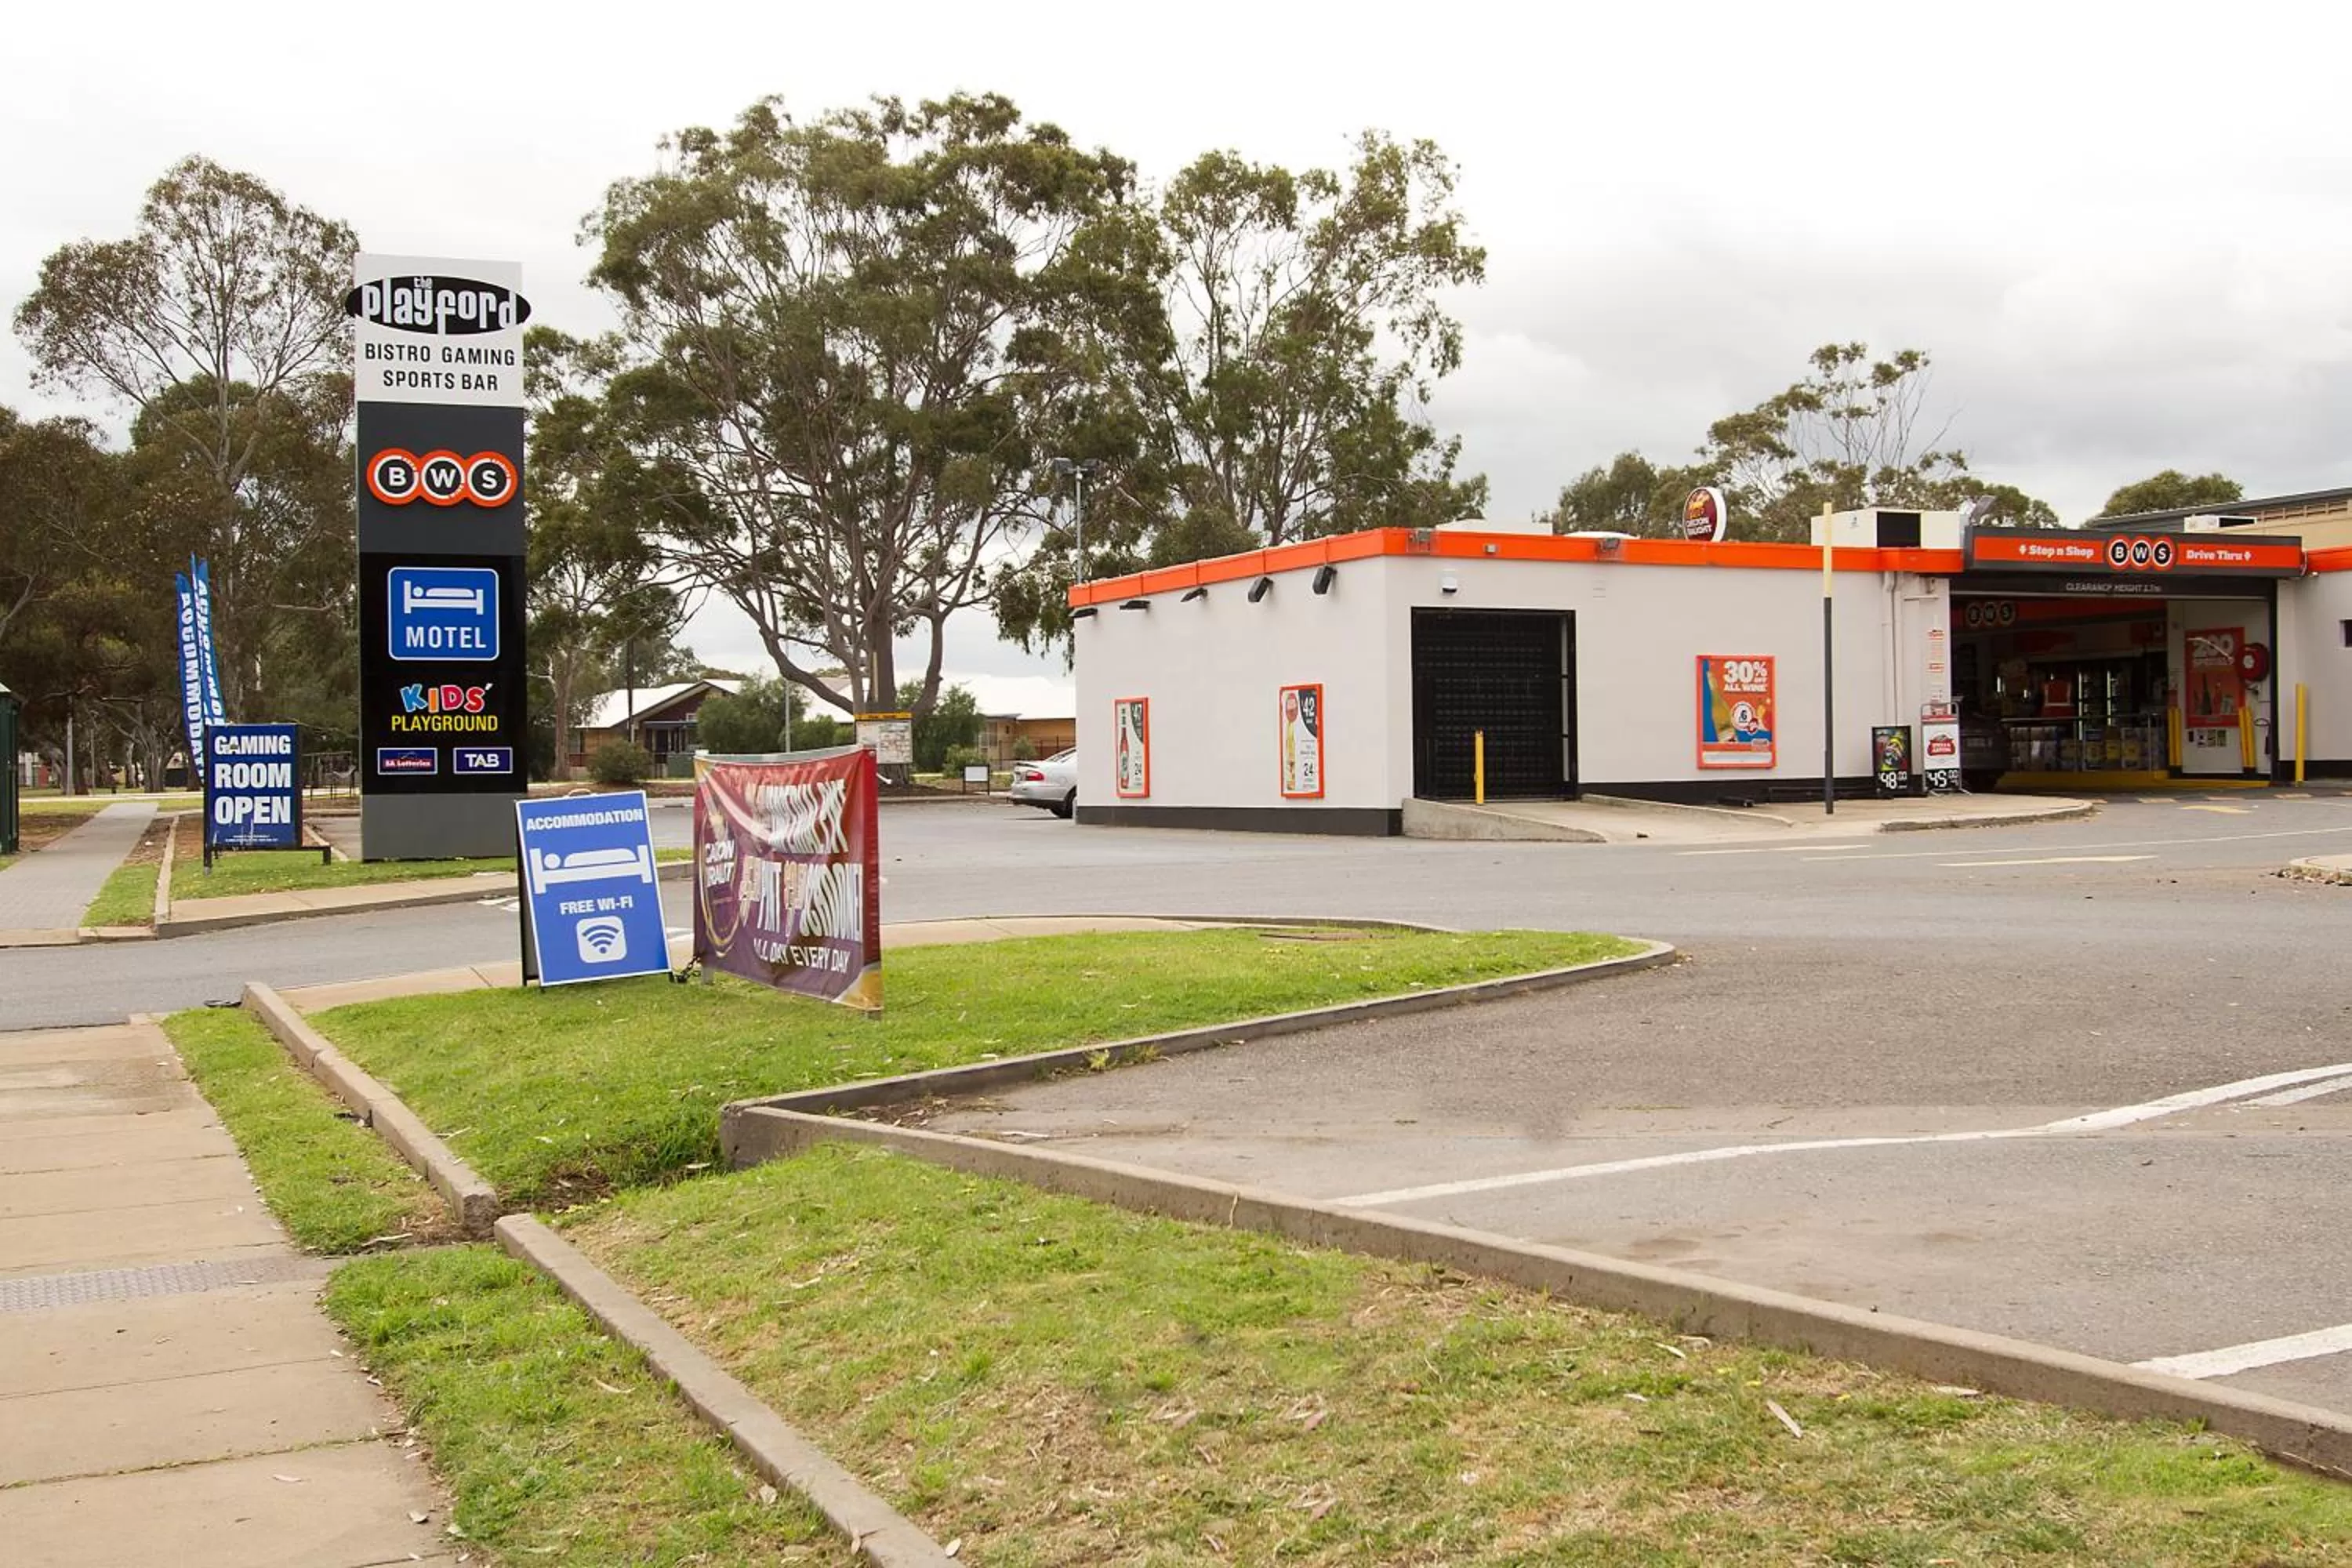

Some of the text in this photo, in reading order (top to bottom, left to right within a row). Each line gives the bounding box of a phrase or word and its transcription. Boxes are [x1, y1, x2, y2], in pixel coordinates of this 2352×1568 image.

[361, 278, 517, 335] playford
[365, 343, 515, 366] BISTRO GAMING
[383, 370, 498, 391] SPORTS BAR
[388, 466, 498, 490] BWS
[2187, 550, 2243, 561] Drive Thru
[405, 626, 487, 649] MOTEL
[391, 715, 498, 732] PLAYGROUND
[214, 735, 291, 755] GAMING
[464, 753, 500, 768] TAB
[214, 763, 291, 789] ROOM
[214, 797, 291, 825] OPEN
[526, 808, 644, 831] ACCOMMODATION
[559, 895, 633, 916] FREE WI-FI
[789, 945, 830, 971] EVERY
[831, 948, 851, 974] DAY
